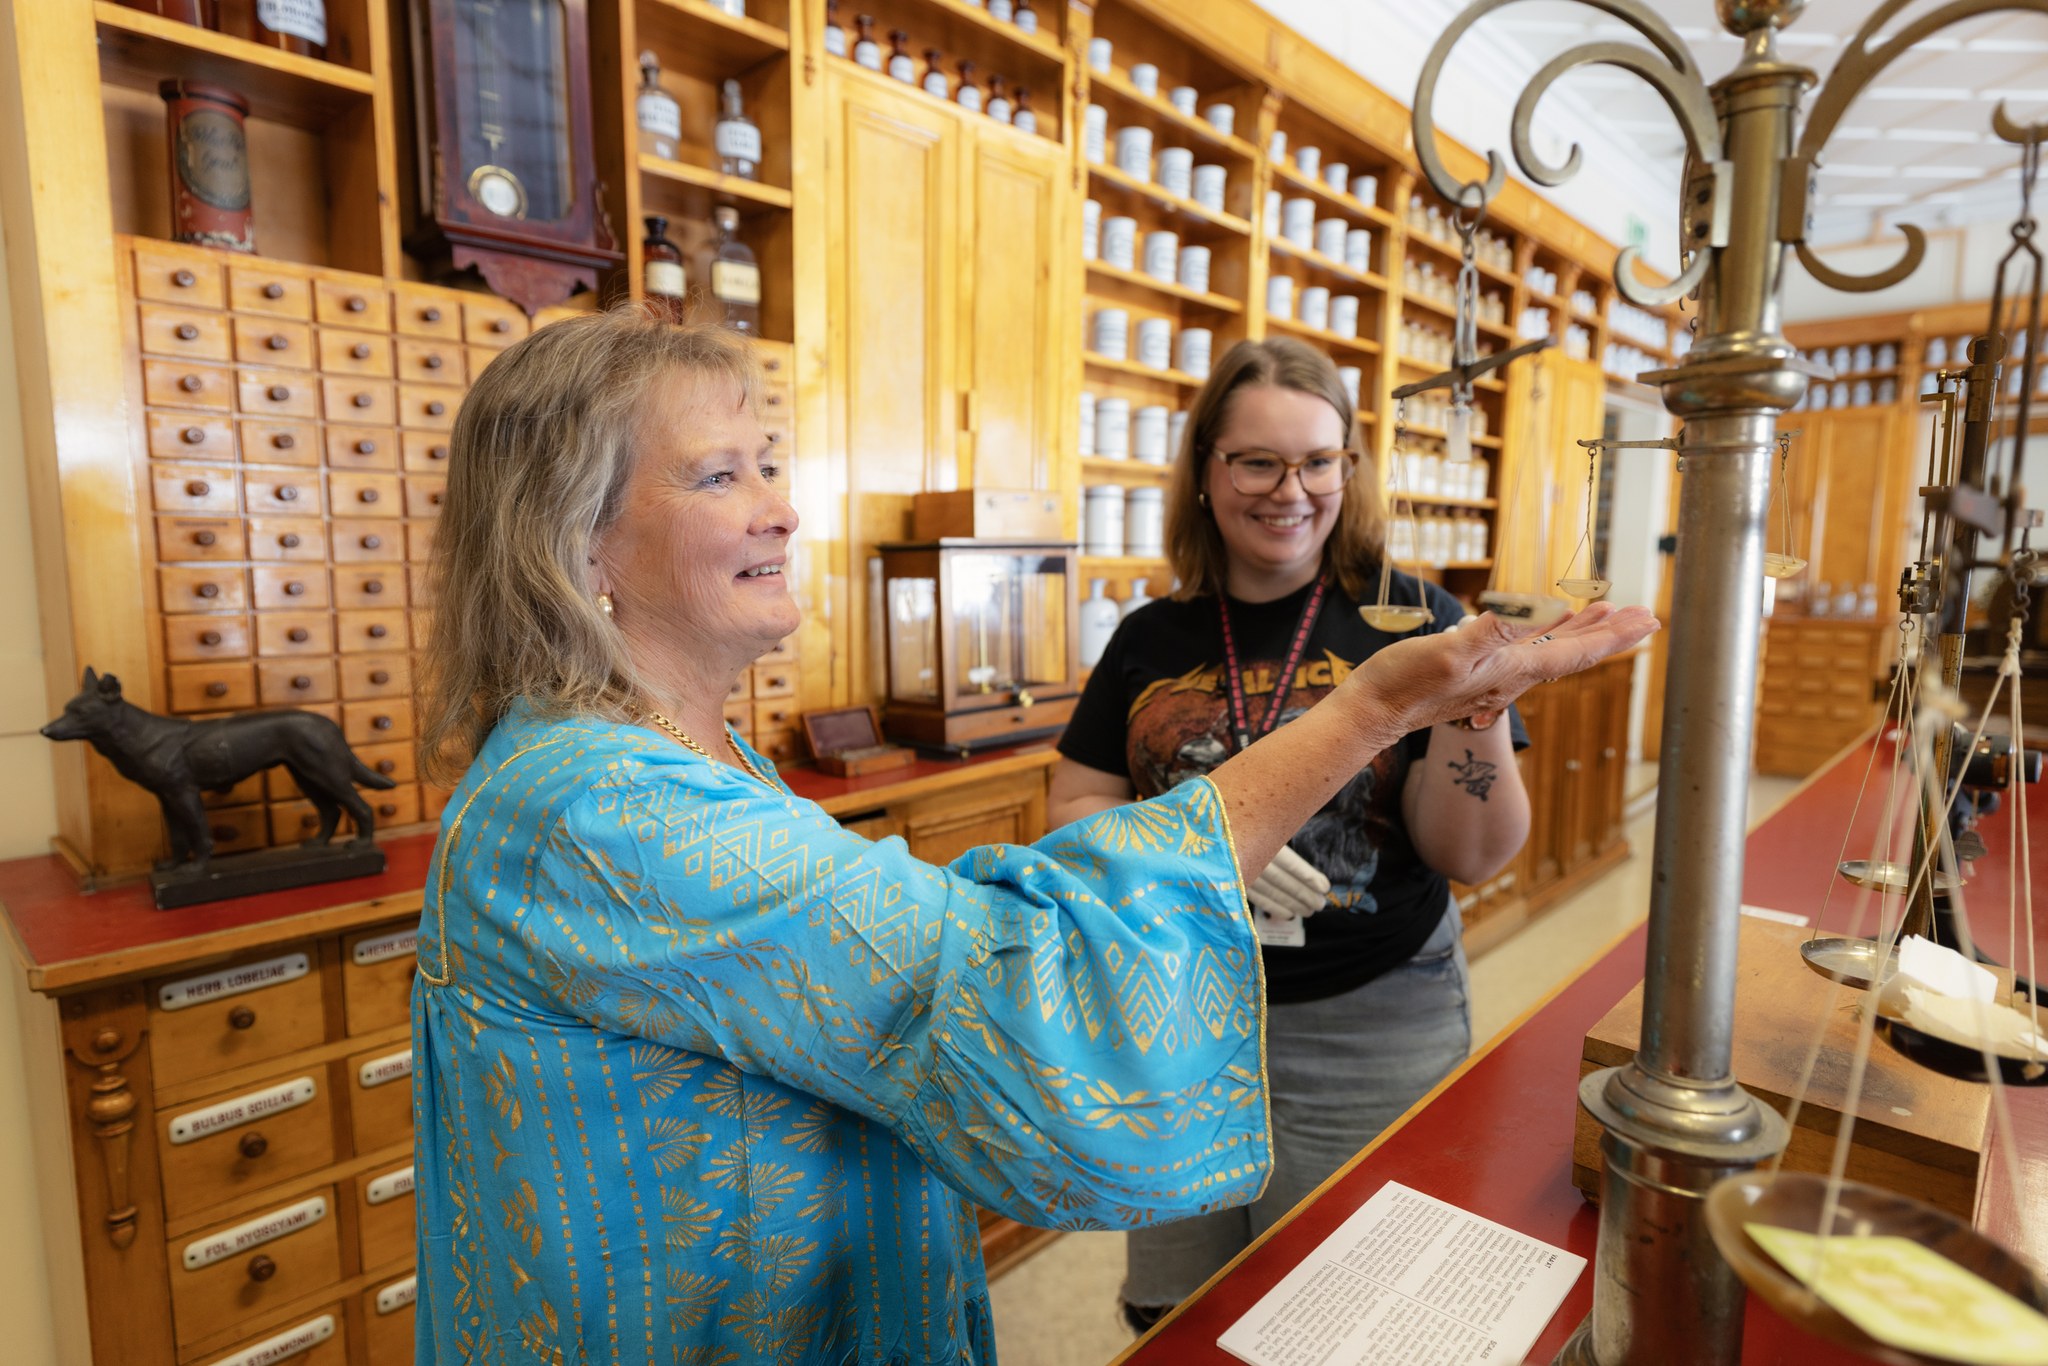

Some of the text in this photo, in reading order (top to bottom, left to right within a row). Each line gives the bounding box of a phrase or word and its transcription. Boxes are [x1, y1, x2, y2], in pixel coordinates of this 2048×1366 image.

[185, 963, 286, 998] HERB. LOBELIAE
[191, 1090, 295, 1132] BULBUS SCILLAE
[204, 1211, 307, 1259] FOL. HYOSCYAMI
